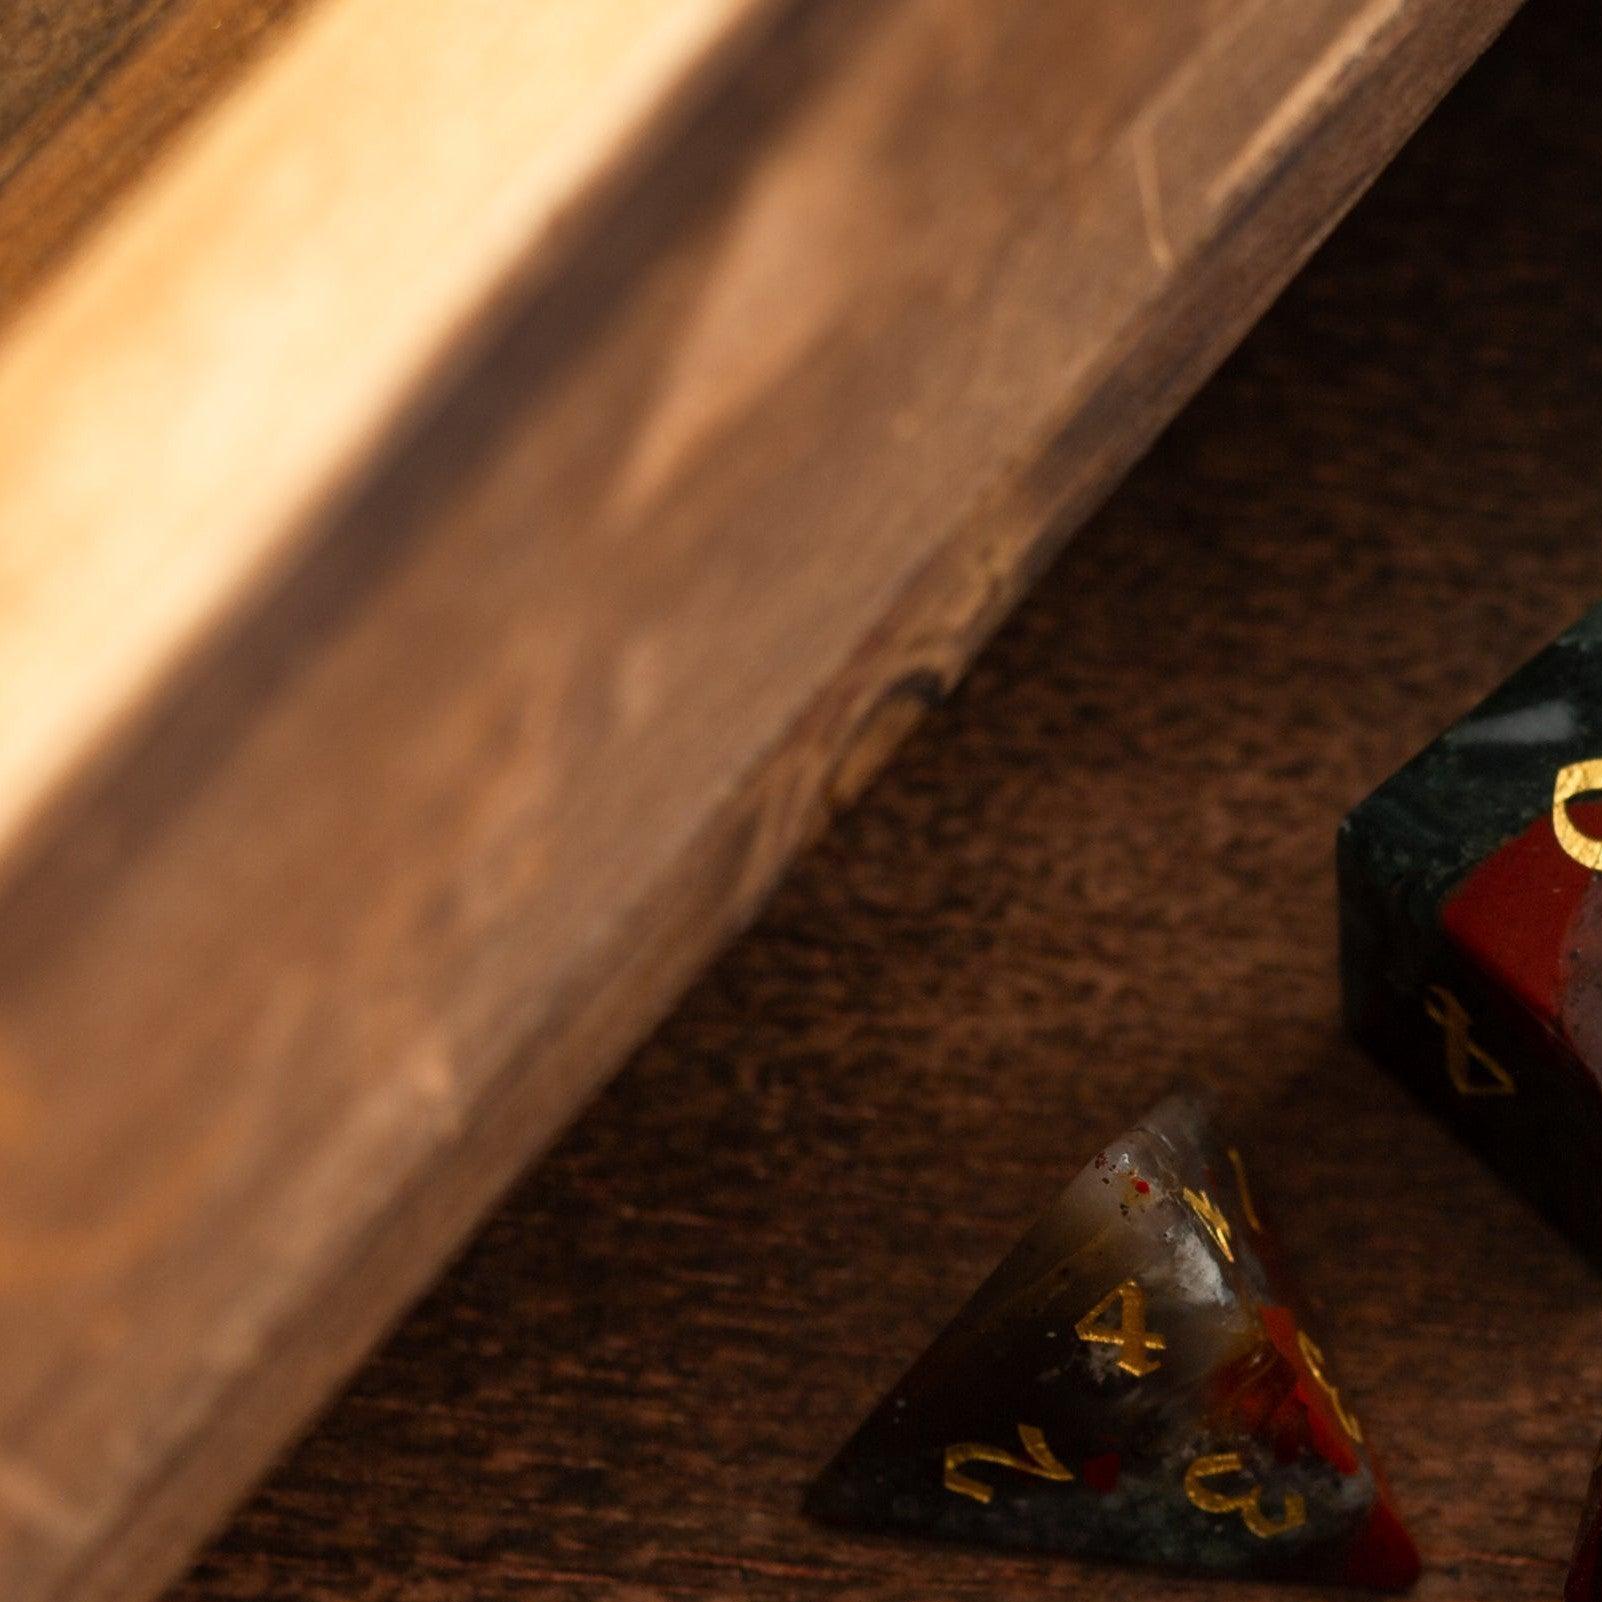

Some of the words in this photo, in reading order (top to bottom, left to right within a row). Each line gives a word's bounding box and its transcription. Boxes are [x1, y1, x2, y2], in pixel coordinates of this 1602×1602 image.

[1074, 1280, 1167, 1378] 4
[944, 1424, 1075, 1505] 2
[1185, 1452, 1306, 1540] 3
